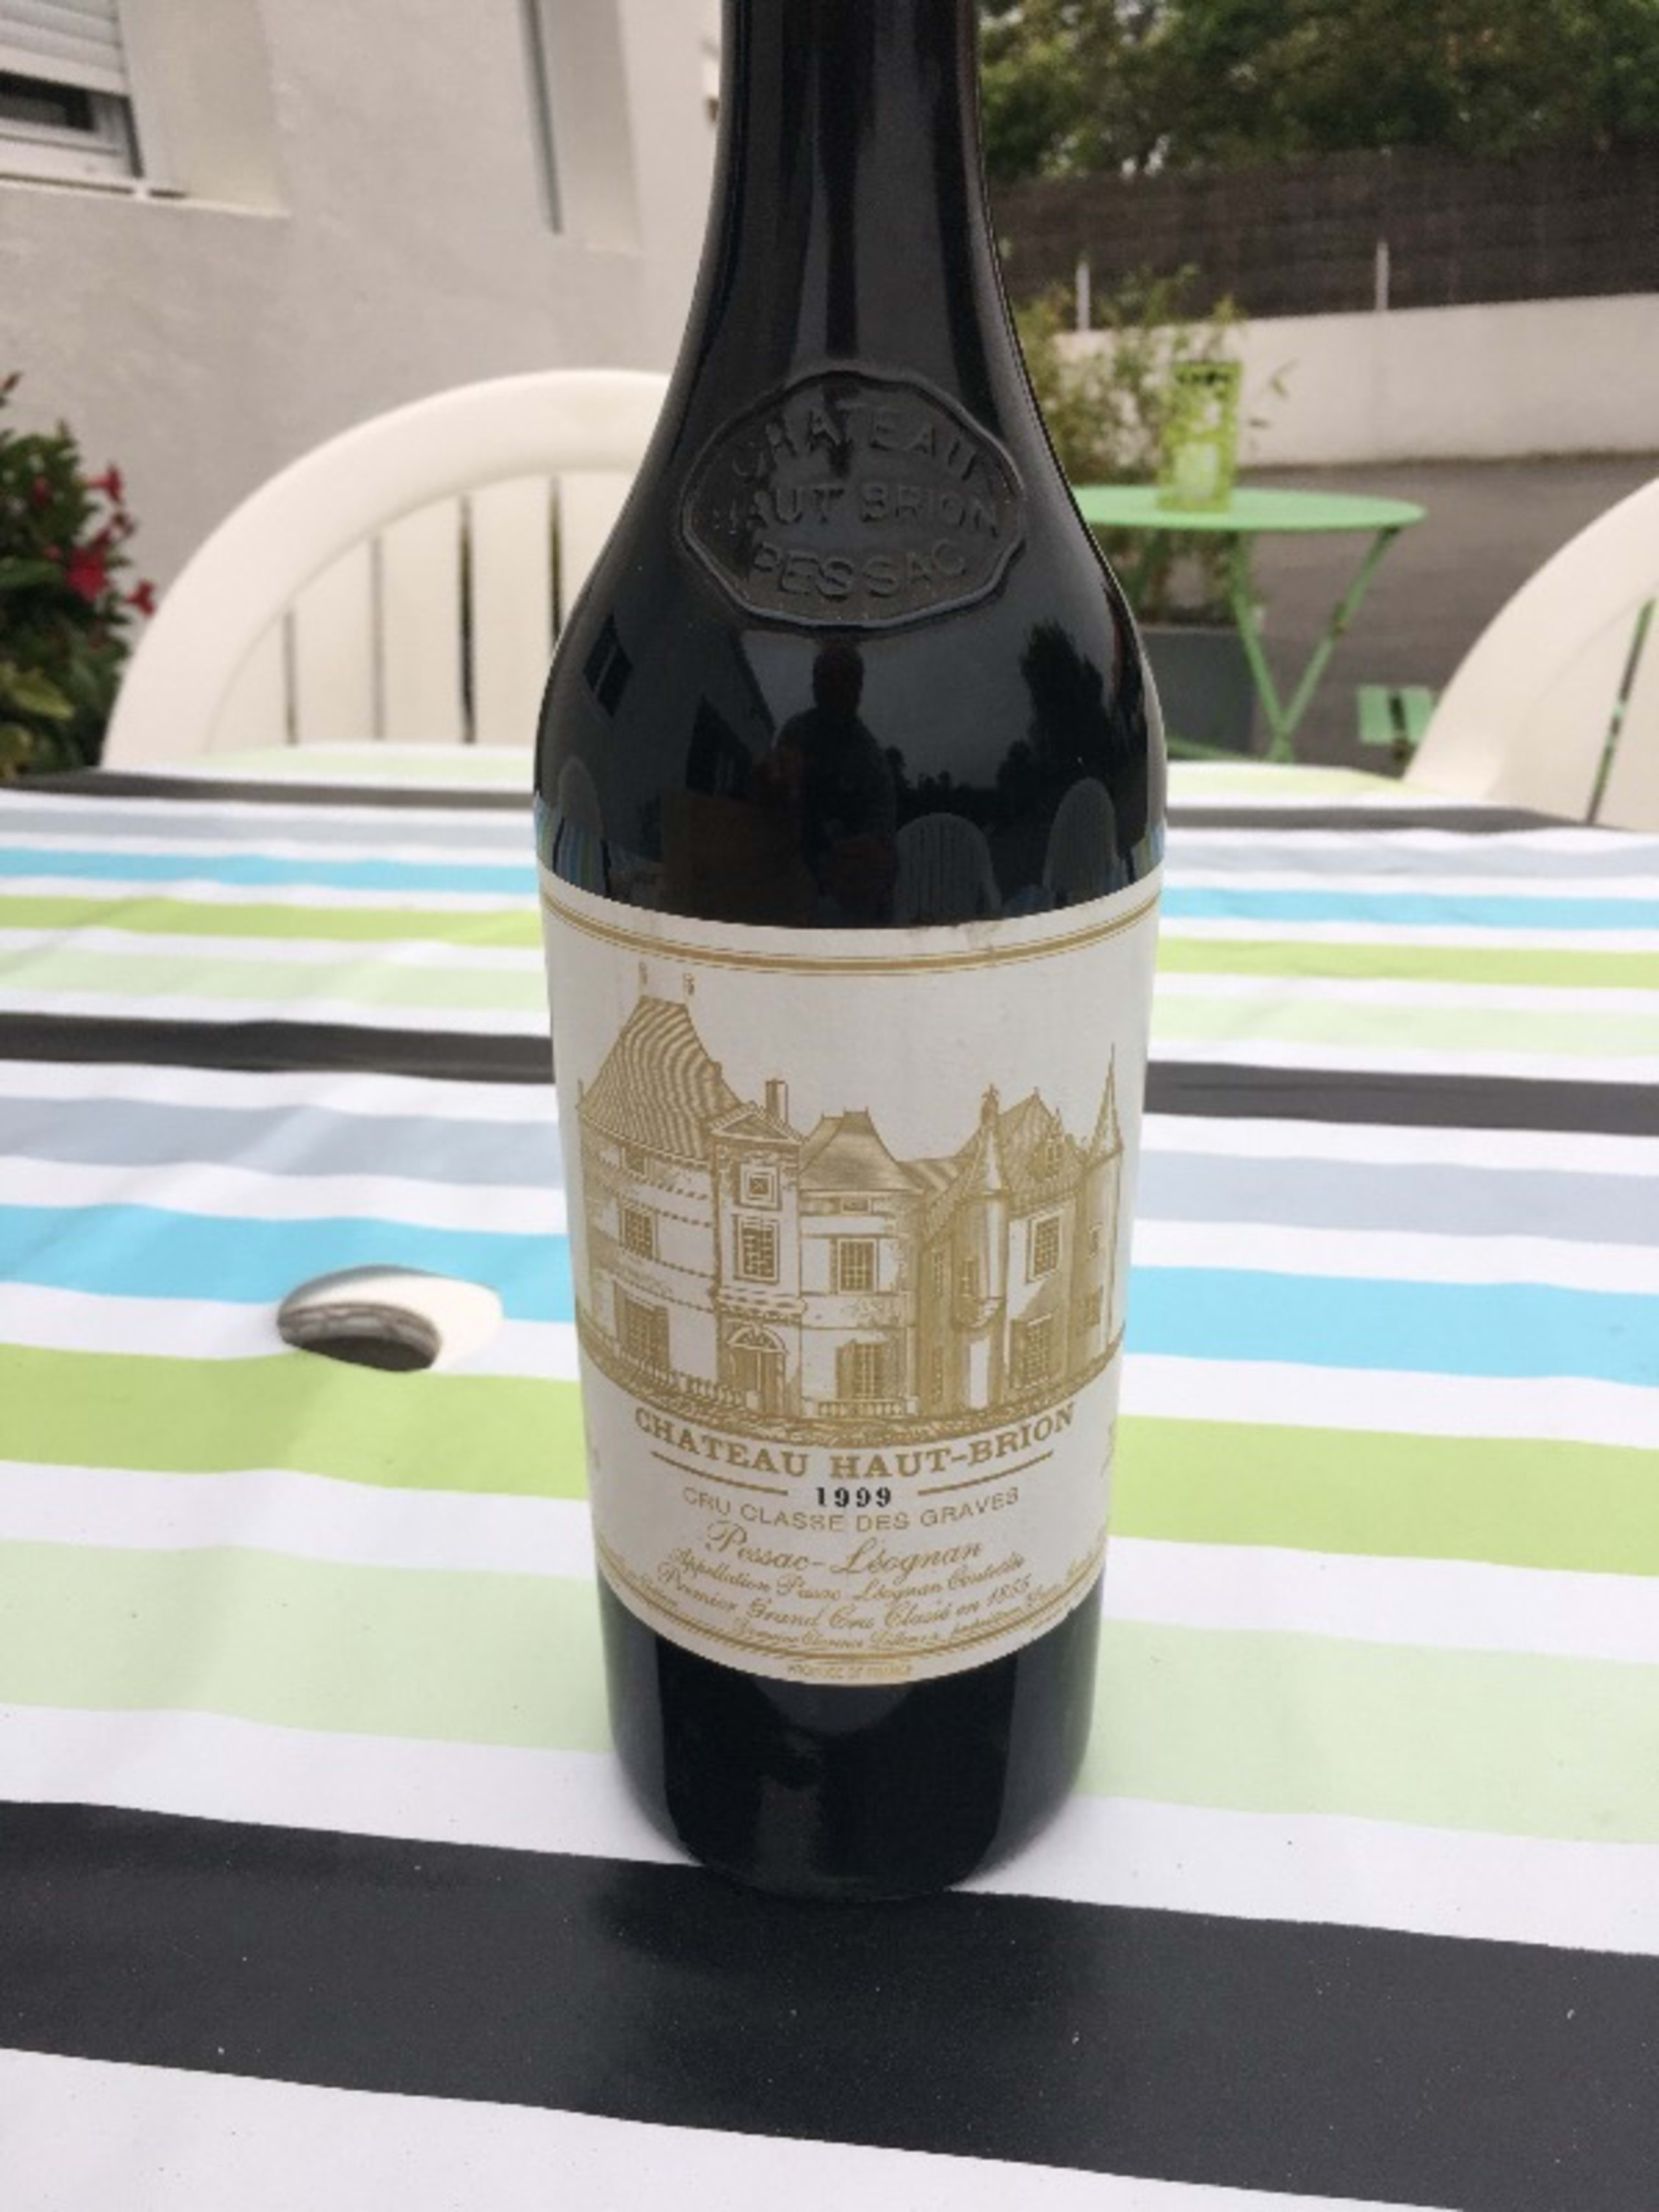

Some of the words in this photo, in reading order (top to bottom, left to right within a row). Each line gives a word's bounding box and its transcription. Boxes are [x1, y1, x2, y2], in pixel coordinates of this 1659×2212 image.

[635, 1408, 808, 1477] CHATEAU
[830, 1402, 1075, 1478] HAUT-BRION
[682, 1487, 732, 1516] CRU
[740, 1503, 844, 1532] CLASSE
[856, 1514, 909, 1531] DES
[920, 1487, 1019, 1527] GRAVES
[817, 1487, 892, 1508] 1999
[656, 1562, 737, 1612] Premier
[746, 1598, 826, 1628] Grand
